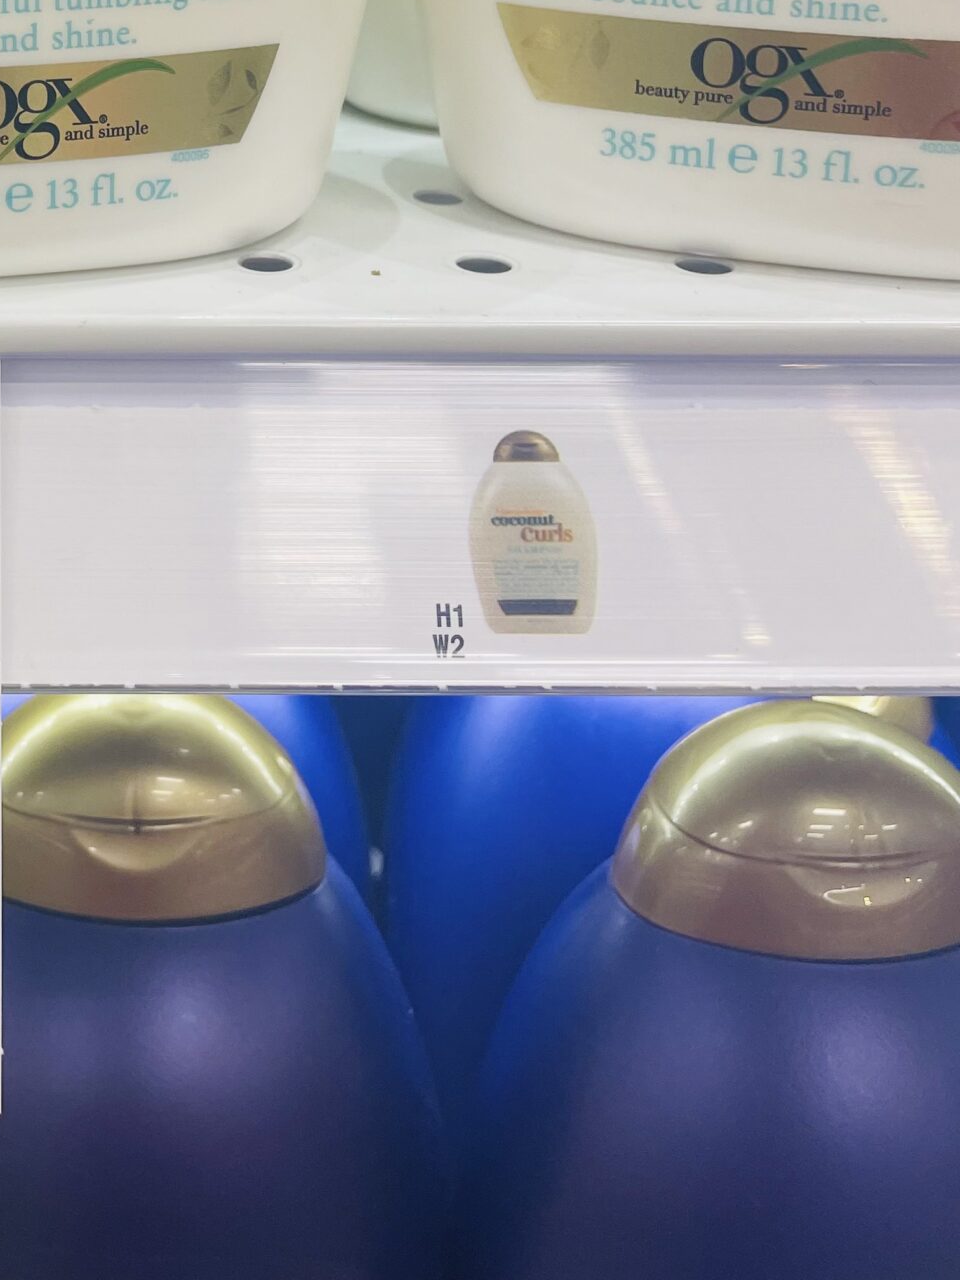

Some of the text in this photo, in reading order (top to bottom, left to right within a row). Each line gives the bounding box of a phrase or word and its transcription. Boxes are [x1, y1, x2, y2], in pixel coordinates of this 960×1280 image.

[52, 19, 137, 51] shine.
[65, 124, 94, 141] and
[98, 120, 149, 140] simple
[600, 128, 925, 188] 385 ml 13 fl. oz.
[47, 177, 79, 209] 13
[91, 174, 123, 205] fl.
[136, 176, 178, 201] oz.
[521, 523, 574, 542] Curls
[436, 603, 463, 627] H1
[433, 634, 465, 658] W2
